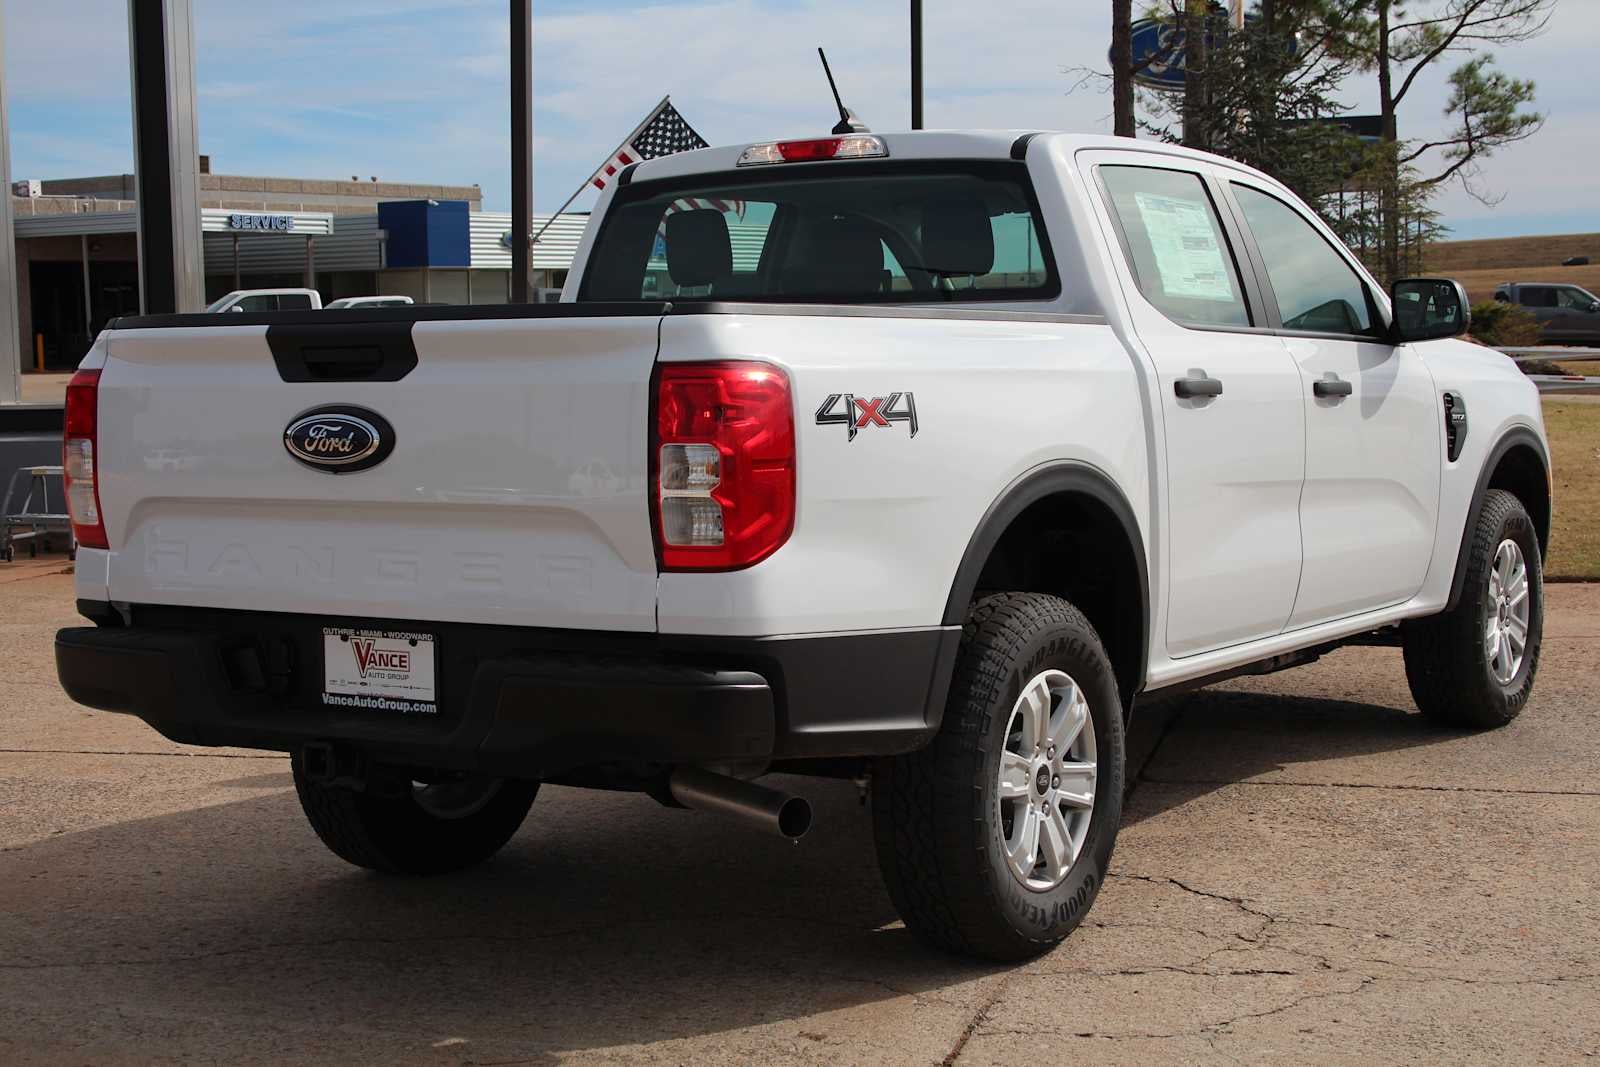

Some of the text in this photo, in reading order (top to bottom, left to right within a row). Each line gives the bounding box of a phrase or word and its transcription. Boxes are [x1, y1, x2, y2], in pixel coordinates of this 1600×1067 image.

[231, 214, 295, 230] SERVICE
[304, 424, 355, 453] Ford
[143, 528, 596, 595] RANGER
[322, 627, 433, 641] GUTHRIE MIAMI WOODWARD
[352, 639, 408, 678] VANCE
[1022, 636, 1103, 677] WRANGLER
[387, 673, 410, 681] GROUP
[321, 693, 437, 713] VanceAutoGroup.com
